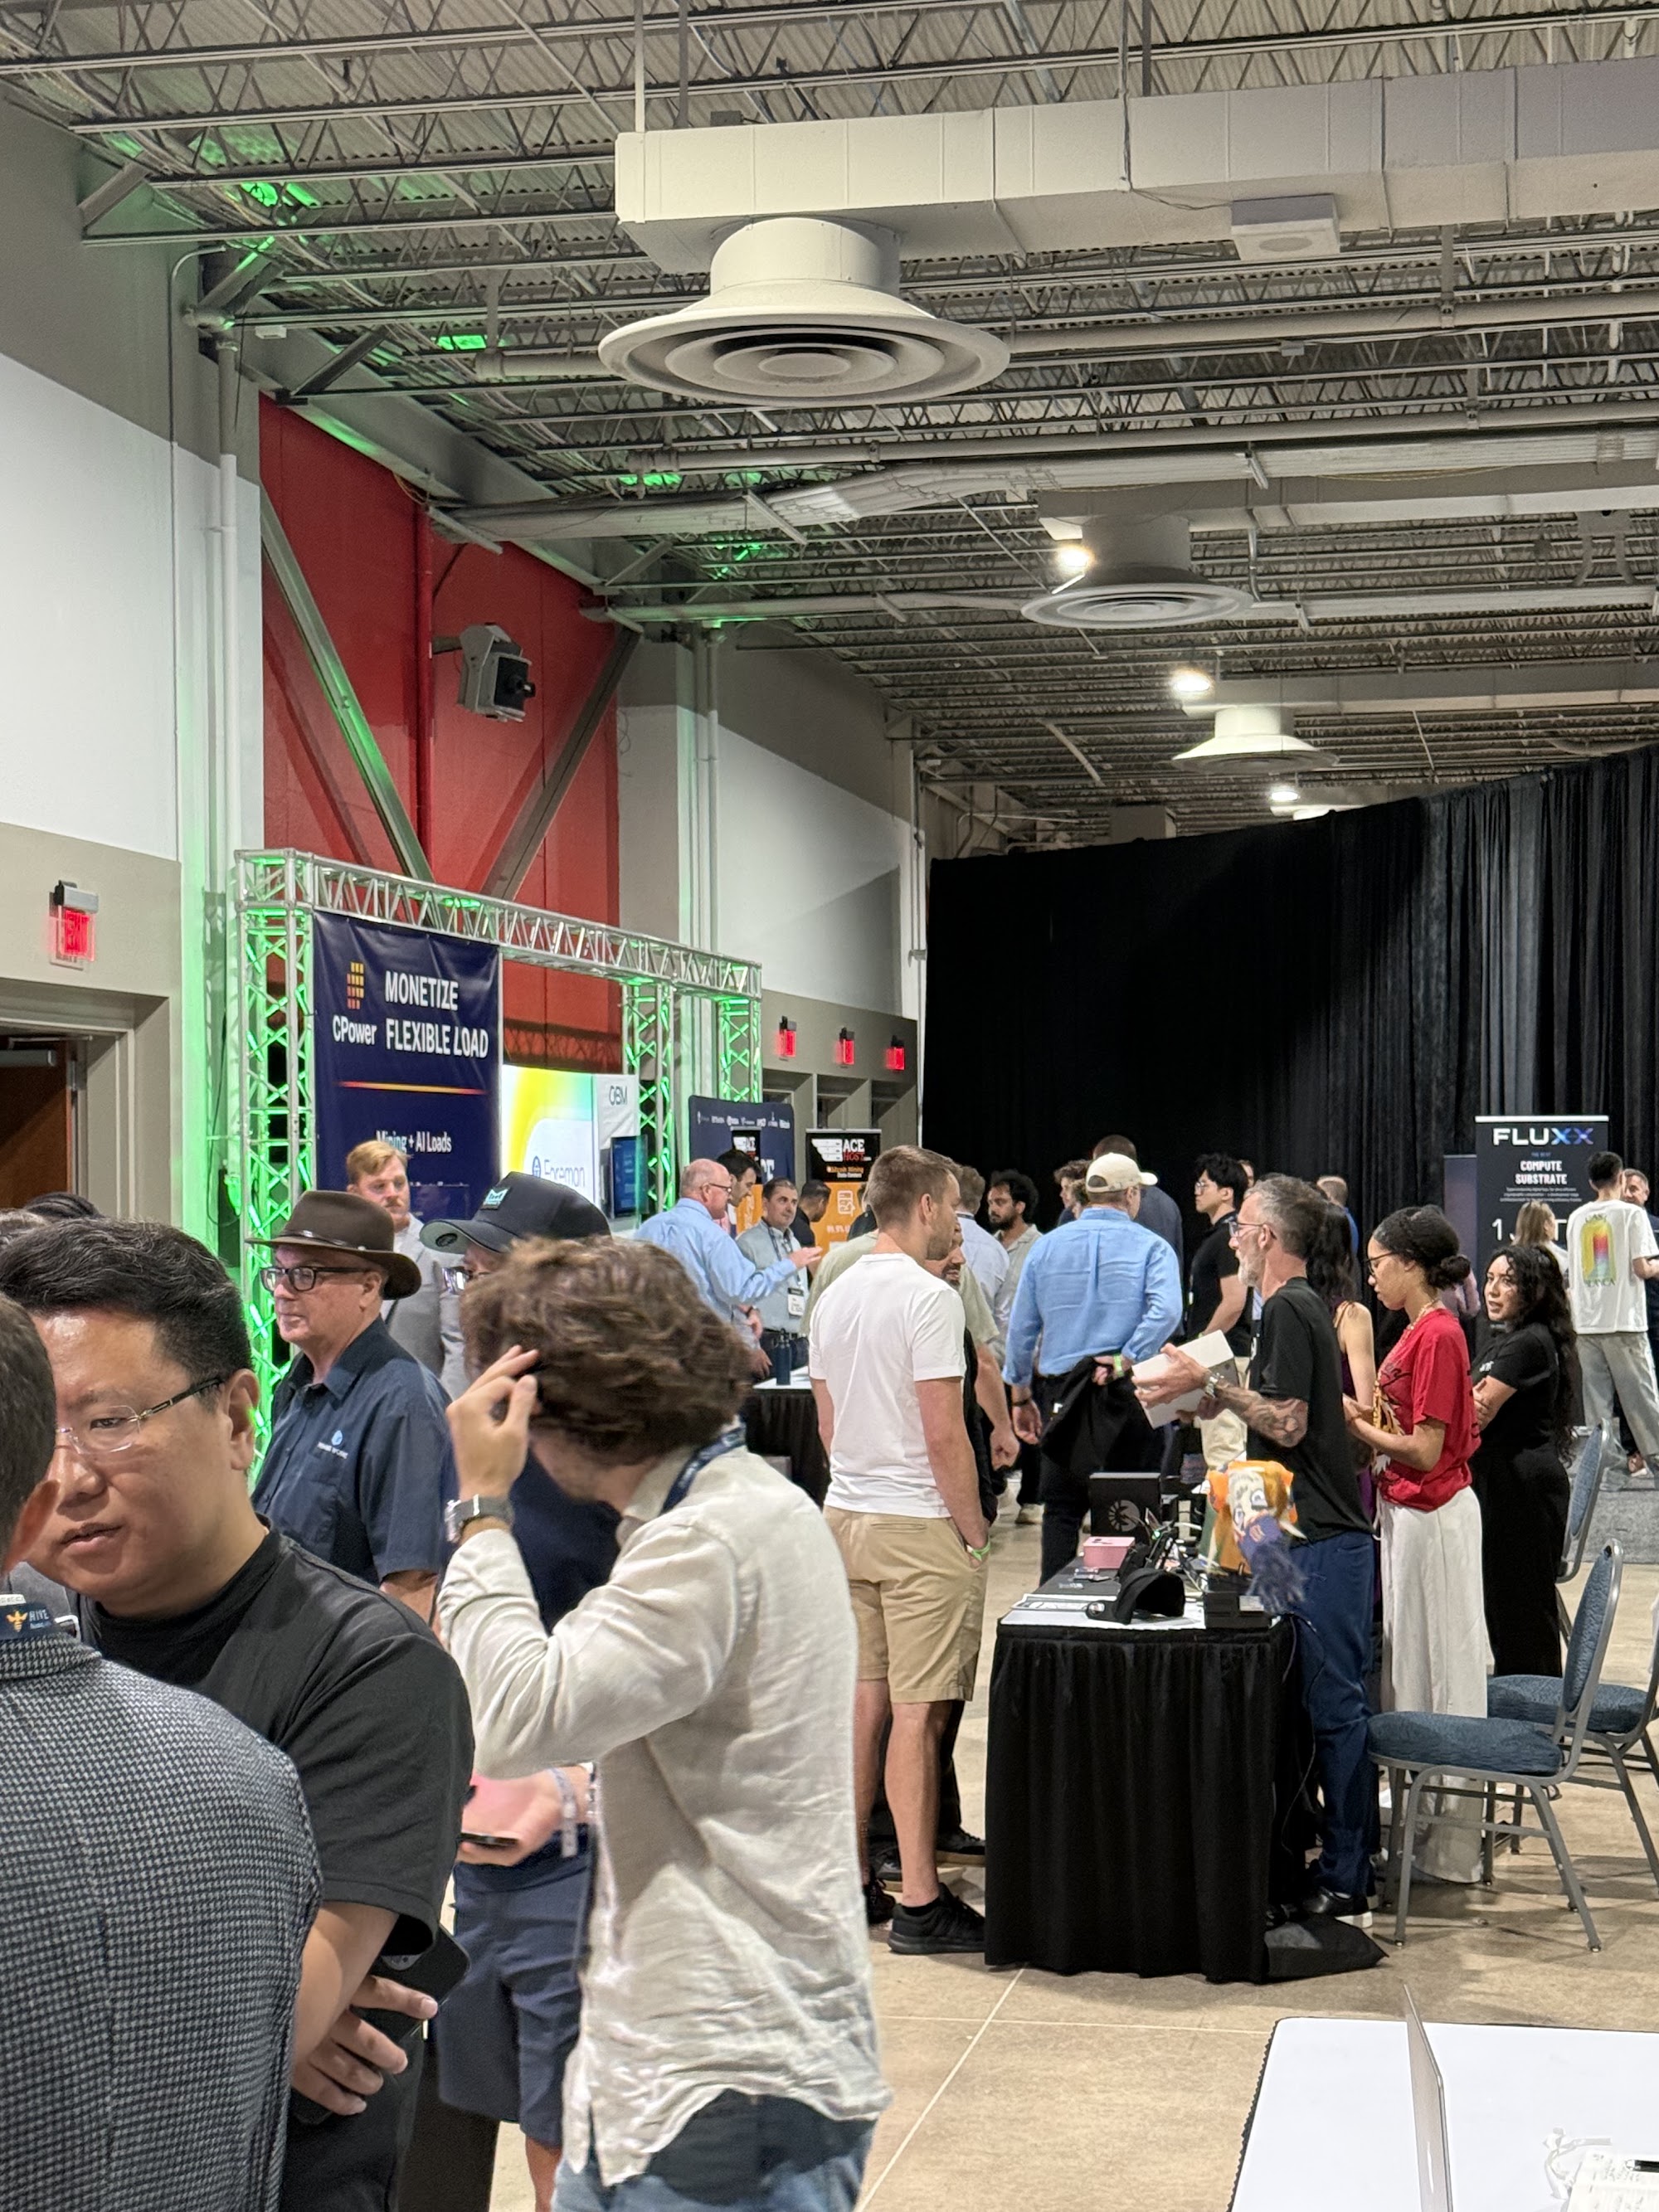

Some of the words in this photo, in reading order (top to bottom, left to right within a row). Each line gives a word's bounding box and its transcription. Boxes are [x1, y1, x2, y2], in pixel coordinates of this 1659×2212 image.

[385, 970, 458, 1011] MONETIZE
[332, 1015, 377, 1045] CPower
[386, 1018, 450, 1055] FLEXIBLE
[454, 1026, 489, 1058] LOAD
[416, 1130, 426, 1152] AI
[426, 1130, 452, 1153] Loads
[1493, 1128, 1593, 1145] FLUXX
[843, 1139, 865, 1152] ACE
[843, 1152, 864, 1161] HOST
[1520, 1161, 1562, 1171] COMPUTE
[1515, 1174, 1567, 1184] SUBSTRATE
